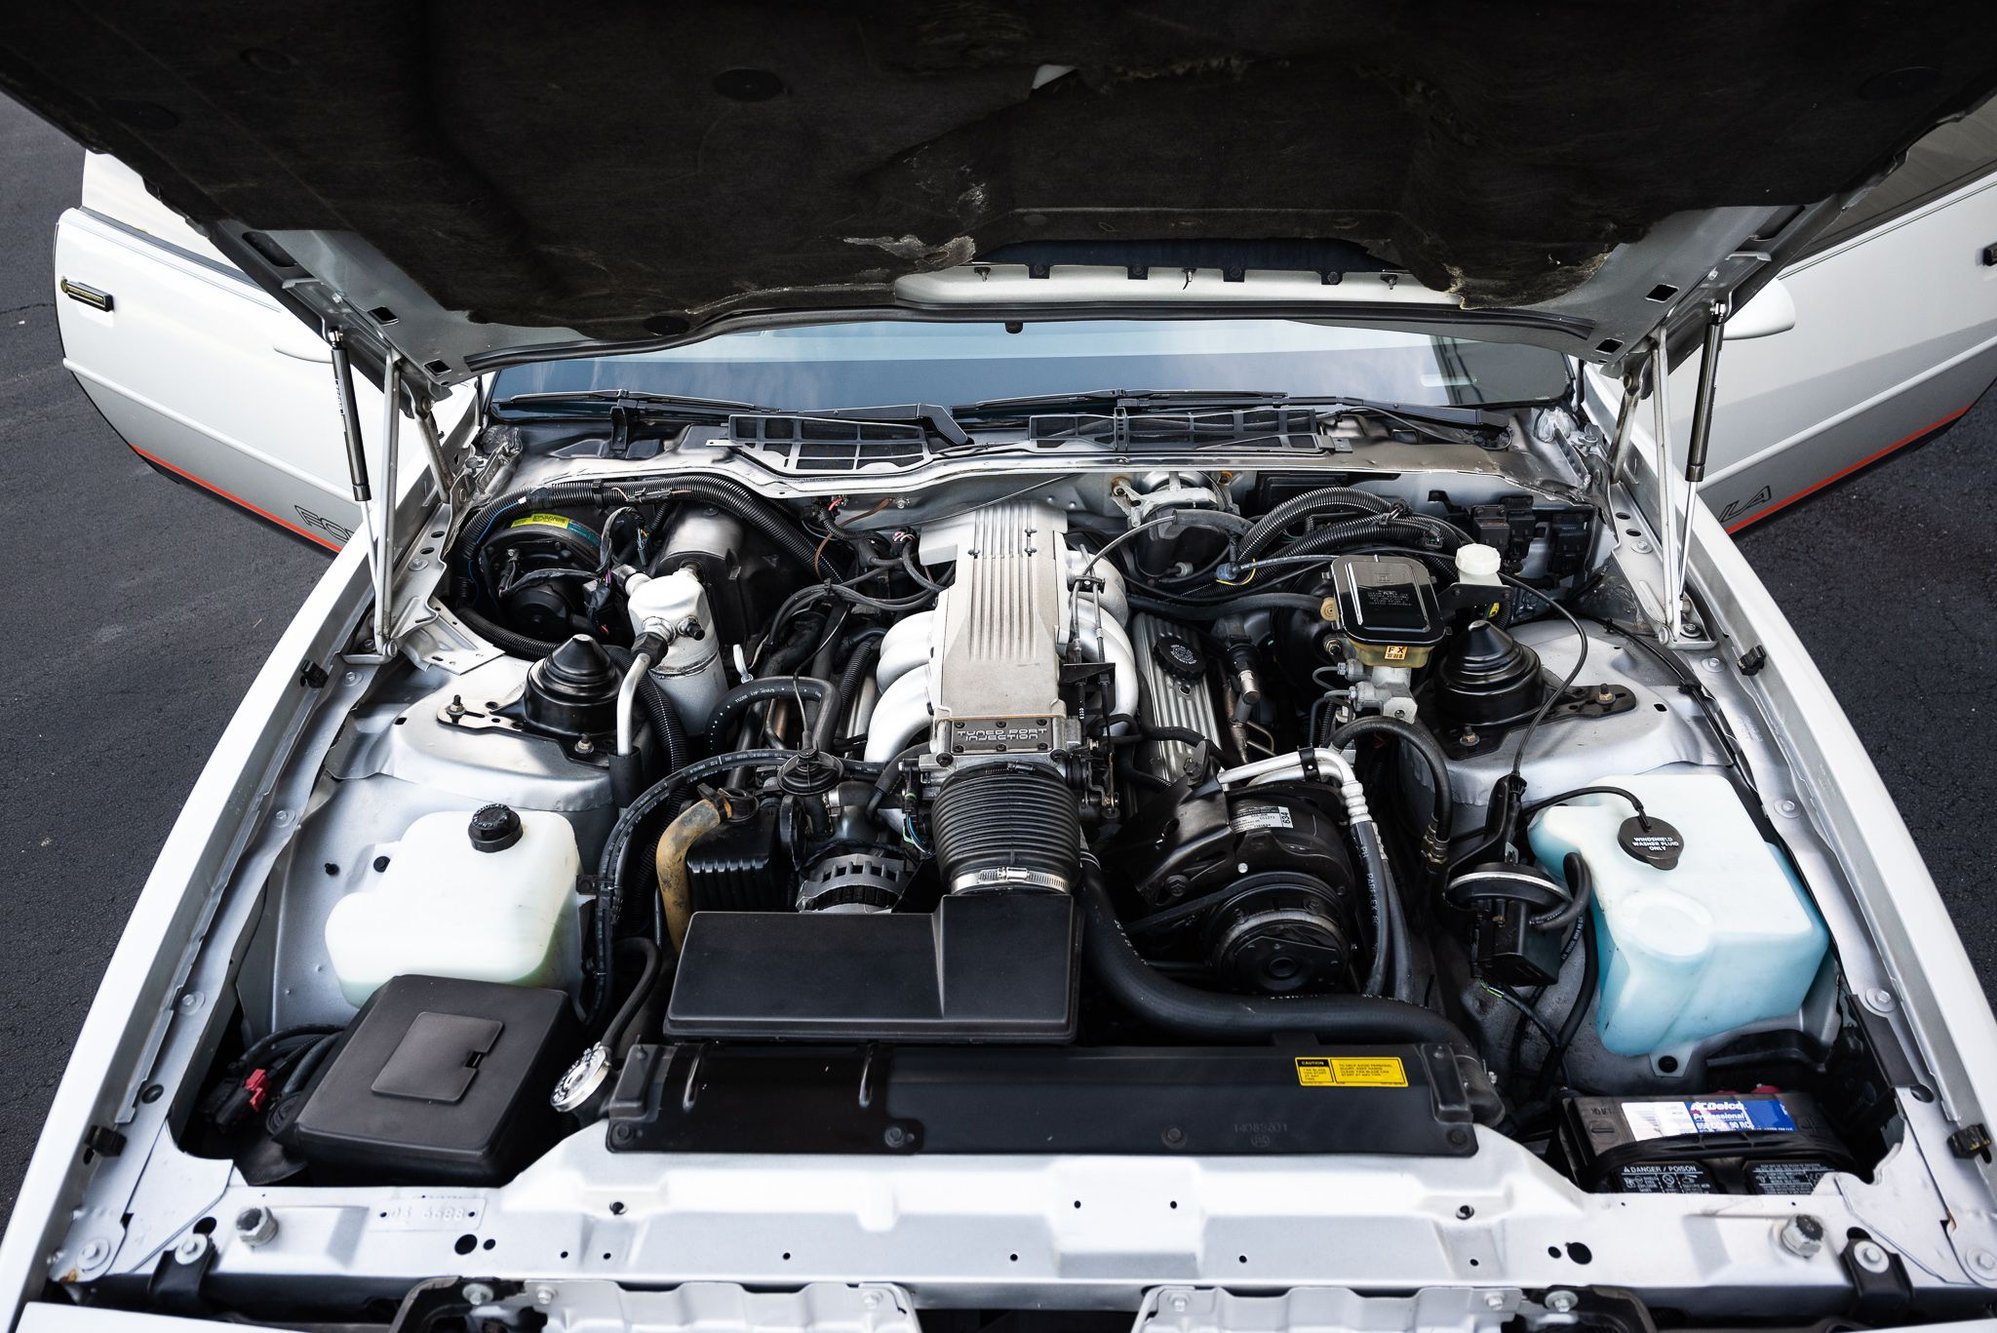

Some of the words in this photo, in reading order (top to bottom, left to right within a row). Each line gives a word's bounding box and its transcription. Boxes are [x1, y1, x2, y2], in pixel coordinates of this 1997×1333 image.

[965, 733, 1039, 741] INJECTION
[1280, 811, 1291, 824] 634
[1690, 1100, 1744, 1111] ACDelco
[1693, 1112, 1745, 1122] Professional
[1630, 1165, 1661, 1173] DANGER
